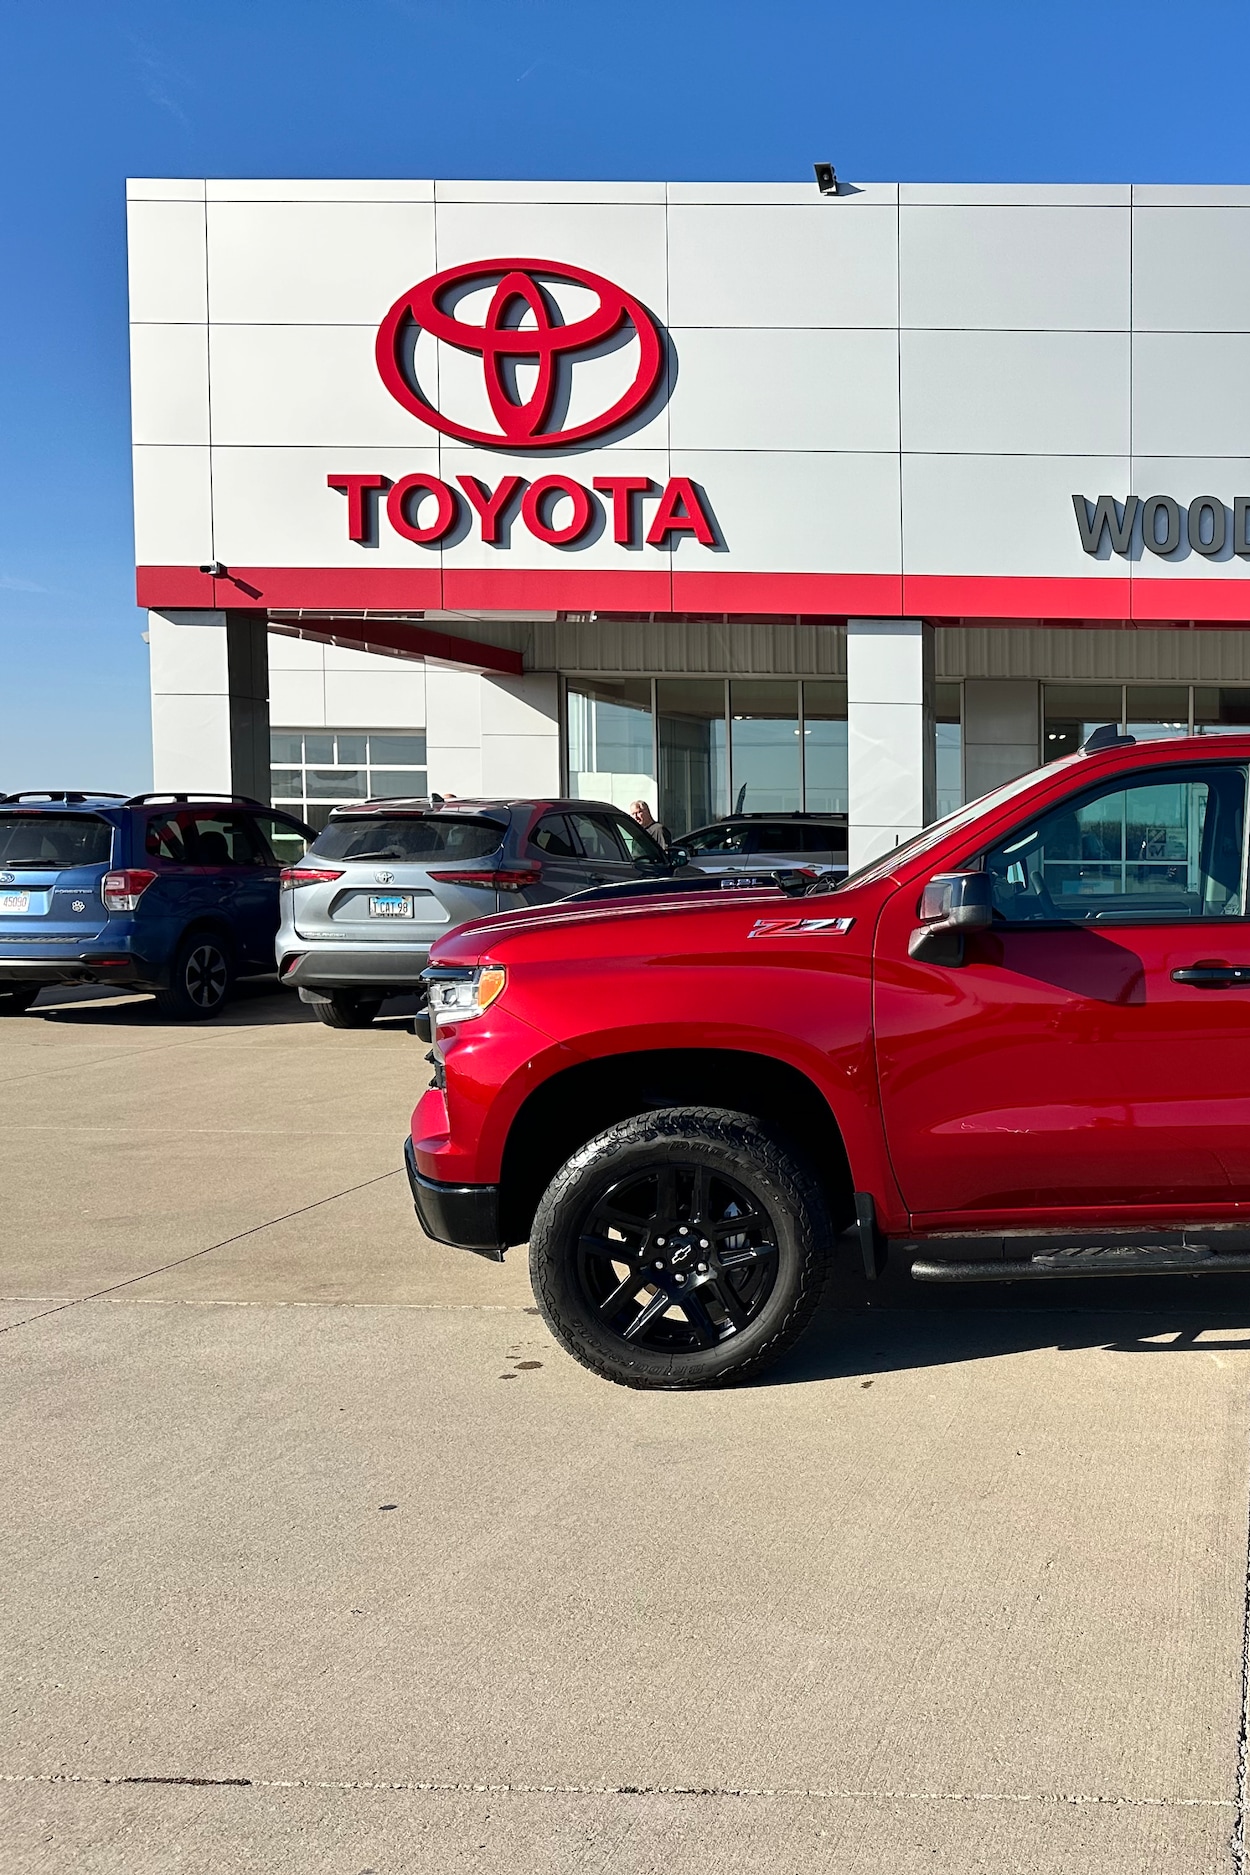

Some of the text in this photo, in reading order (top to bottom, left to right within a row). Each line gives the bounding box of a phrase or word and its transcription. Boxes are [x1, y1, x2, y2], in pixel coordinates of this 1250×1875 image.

[326, 473, 718, 546] TOYOTA
[380, 901, 396, 913] CAT
[397, 902, 409, 913] 98
[746, 917, 857, 939] Z71
